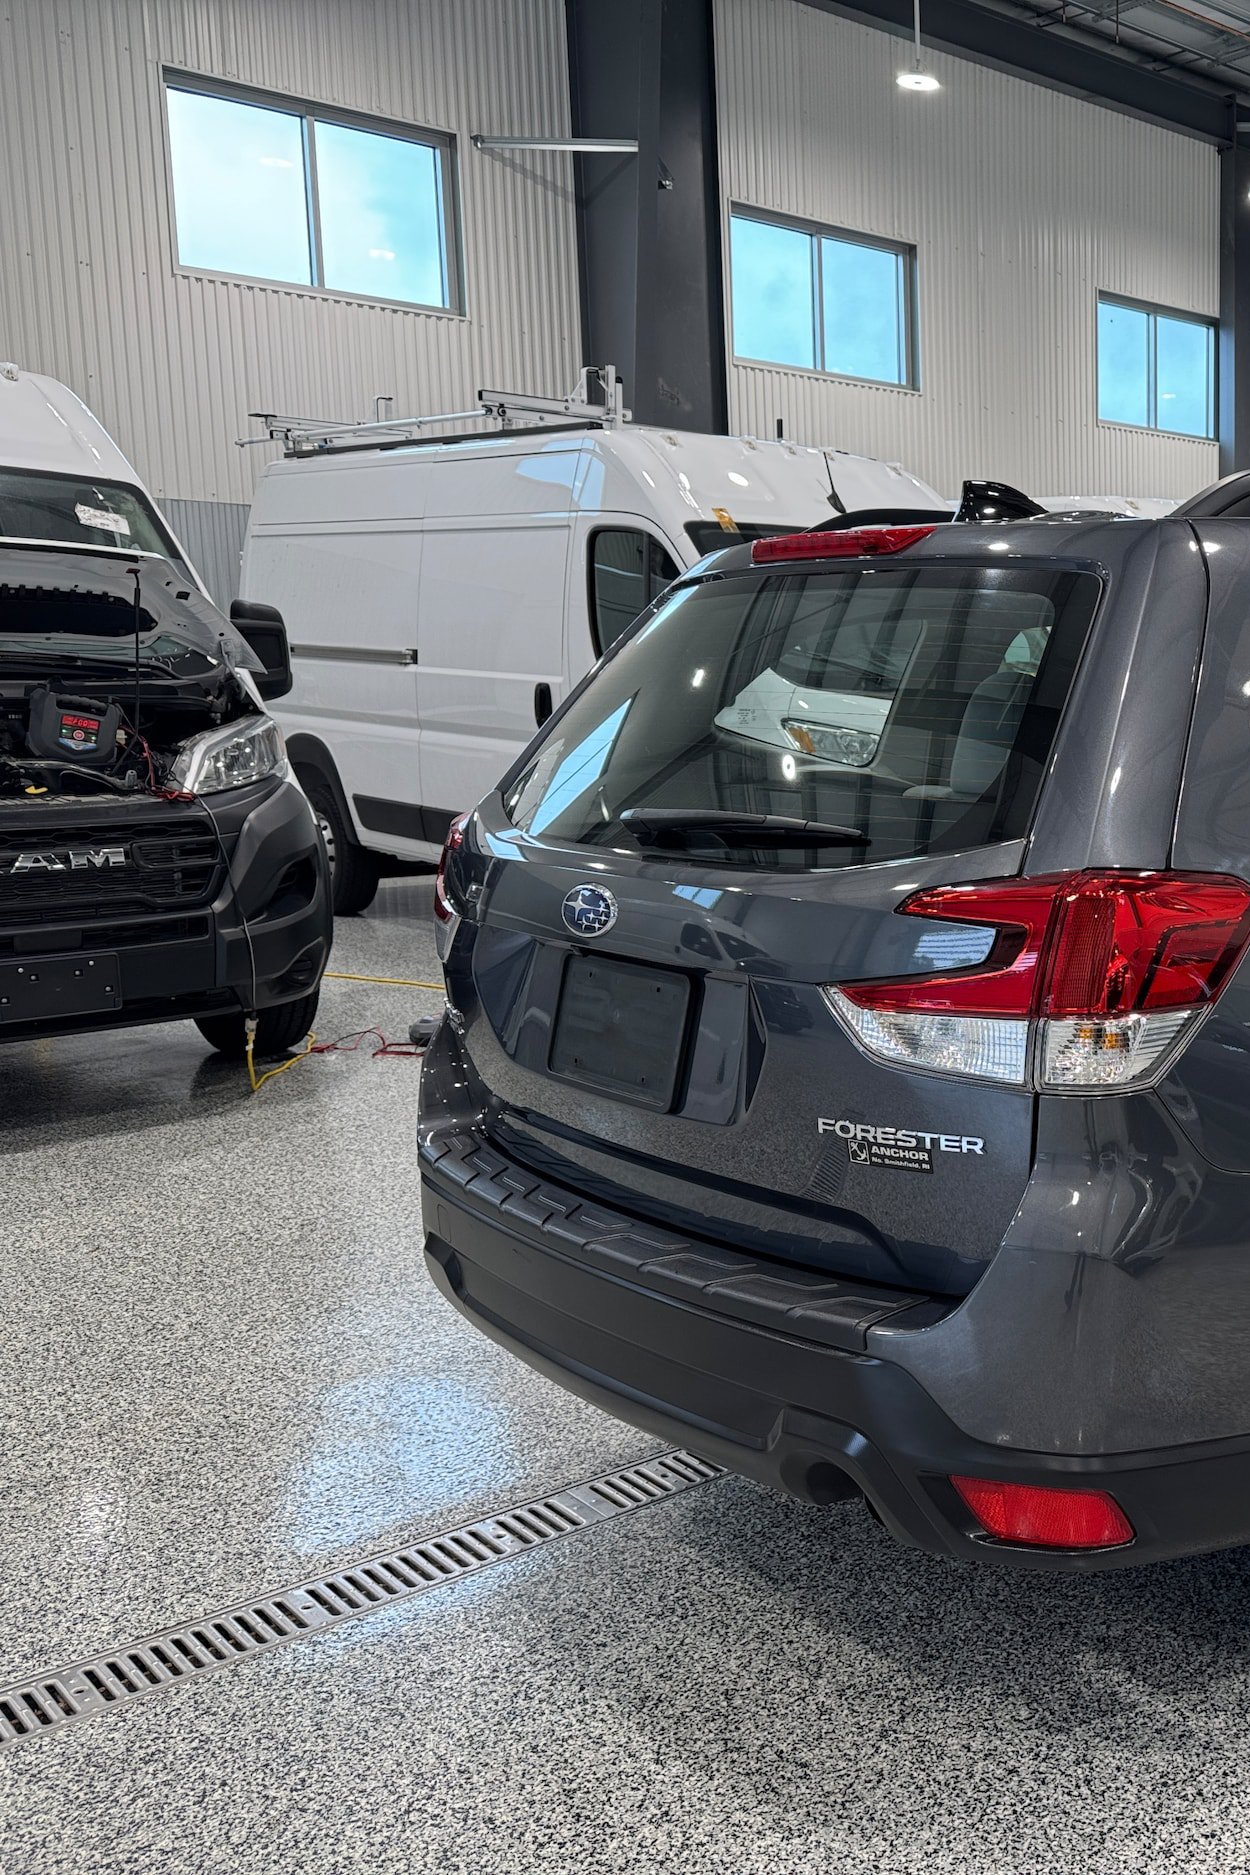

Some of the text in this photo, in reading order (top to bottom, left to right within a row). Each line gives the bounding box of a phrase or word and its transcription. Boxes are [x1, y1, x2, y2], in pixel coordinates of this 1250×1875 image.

[0, 848, 126, 874] AM
[817, 1117, 985, 1155] FORESTER
[871, 1145, 929, 1161] ANCHOR
